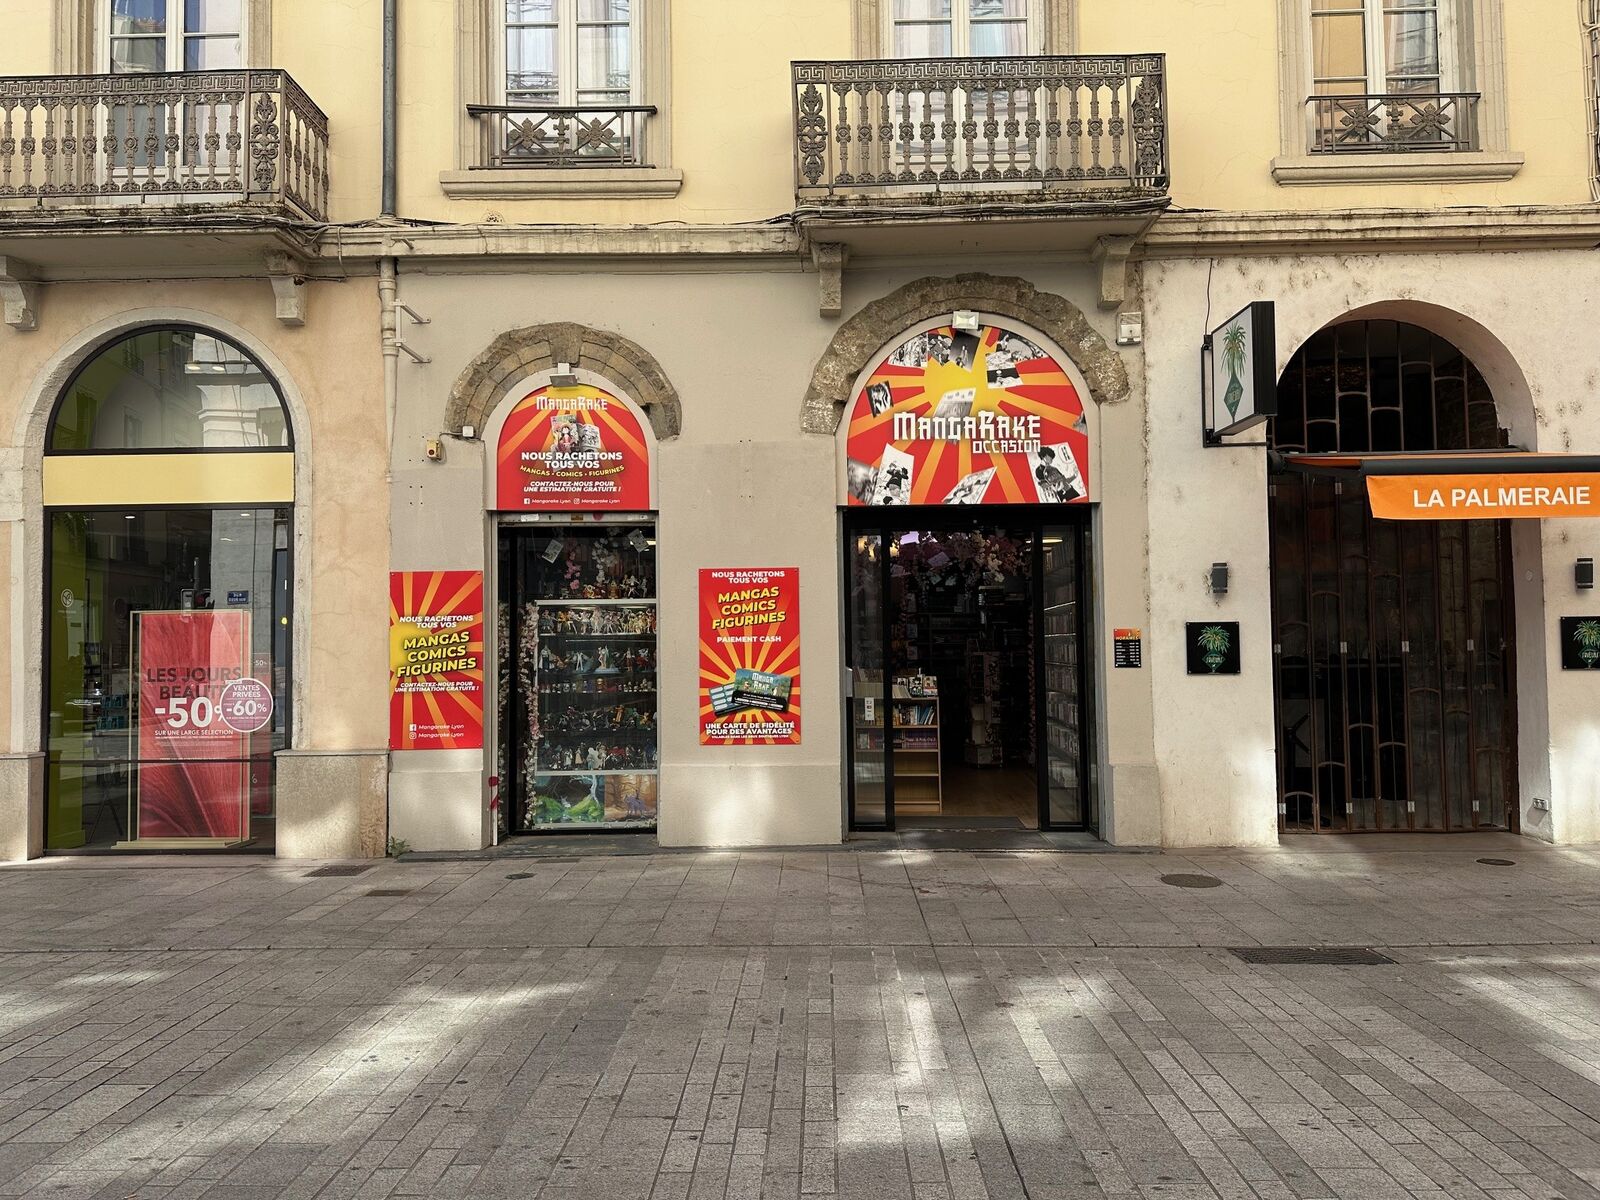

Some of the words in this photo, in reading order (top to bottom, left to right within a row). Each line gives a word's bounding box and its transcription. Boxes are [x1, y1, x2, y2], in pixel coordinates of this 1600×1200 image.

[973, 440, 1041, 454] OCCASION
[521, 452, 552, 460] NOUS
[555, 452, 623, 461] RACHETONS
[544, 460, 575, 469] TOUS
[577, 460, 600, 469] VOS
[520, 465, 550, 476] MANGAS
[588, 465, 625, 477] FIGURINES
[1413, 489, 1445, 507] LA
[1451, 487, 1591, 507] PALMERAIE
[718, 586, 780, 604] MANGAS
[721, 600, 776, 616] COMICS
[400, 615, 423, 623] NOUS
[712, 611, 786, 630] FIGURINES
[404, 631, 470, 650] MANGAS
[407, 645, 466, 663] COMICS
[147, 667, 176, 683] LES
[182, 667, 242, 683] JOURS
[397, 657, 477, 678] FIGURINES
[232, 690, 261, 698] PRIVÉES
[226, 700, 267, 716] -60%
